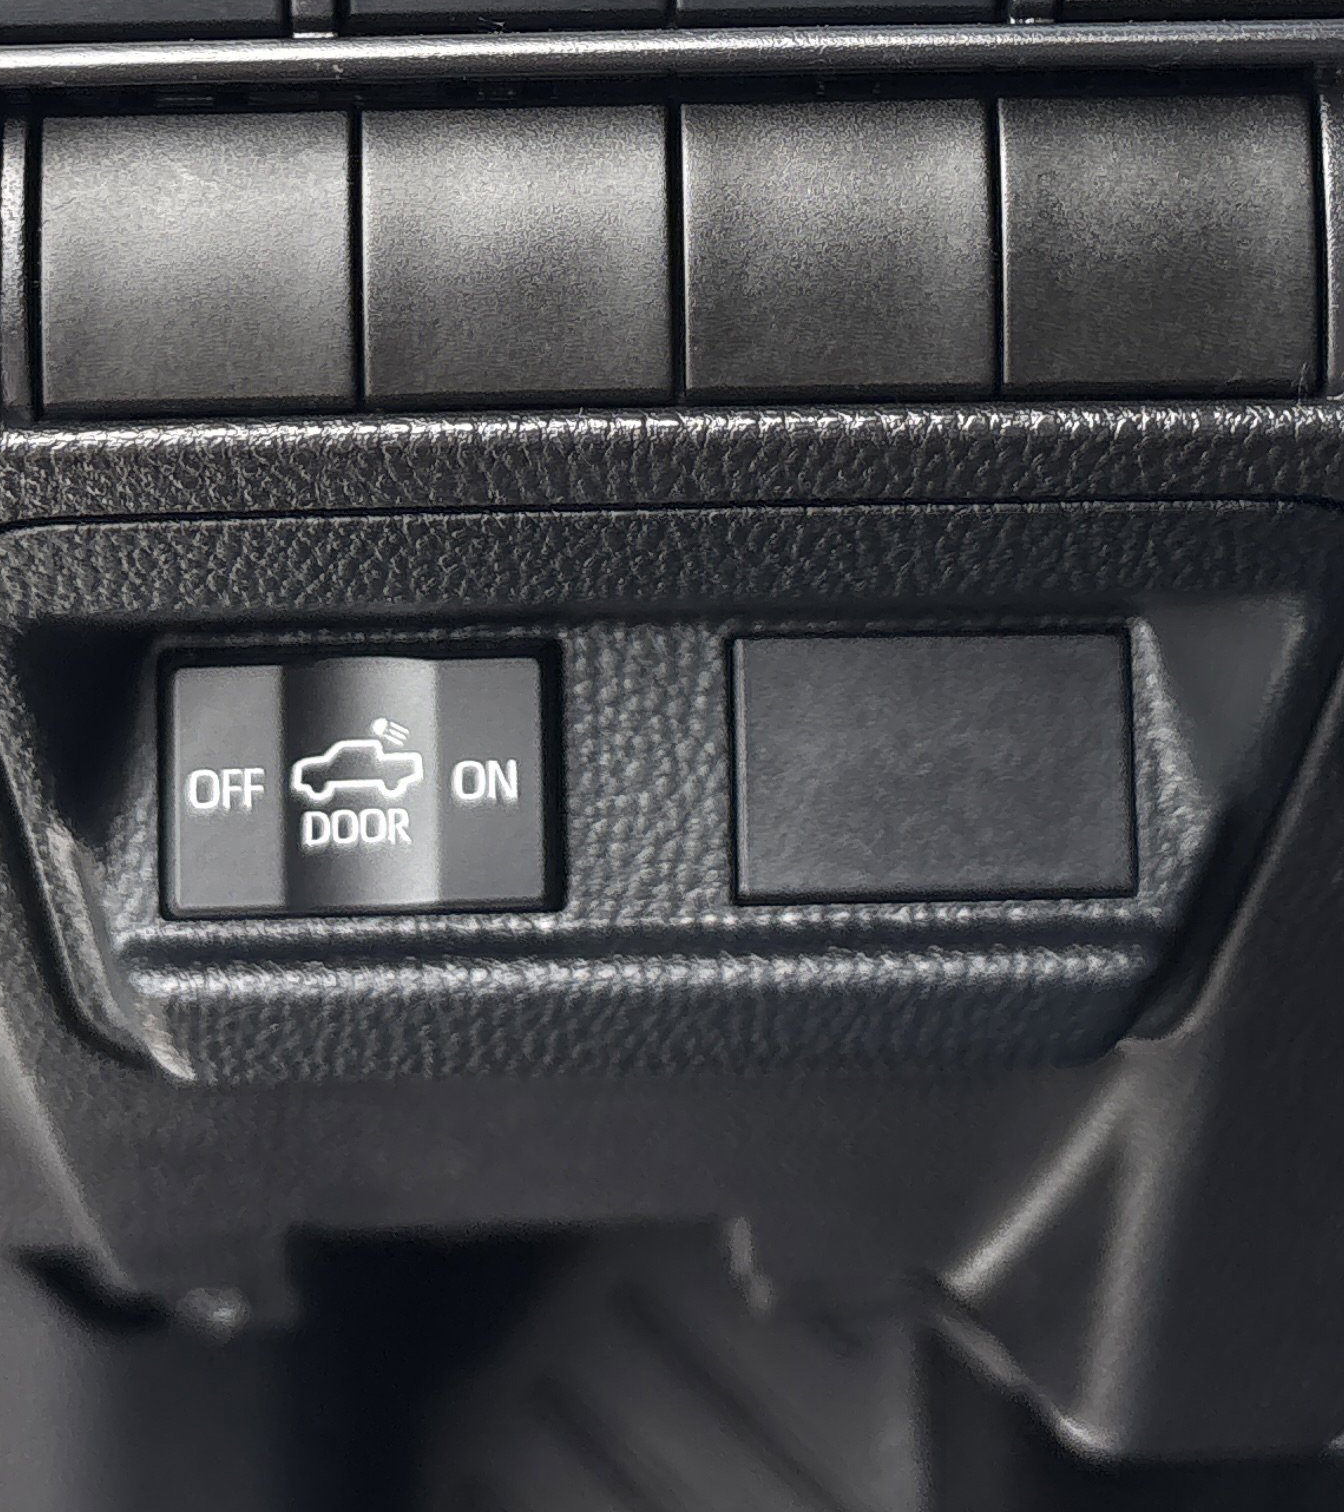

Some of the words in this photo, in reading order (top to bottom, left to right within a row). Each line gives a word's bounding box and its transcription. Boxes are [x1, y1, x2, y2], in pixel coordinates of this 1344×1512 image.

[187, 768, 266, 811] OFF
[453, 759, 518, 801] ON
[303, 808, 412, 847] DOOR
